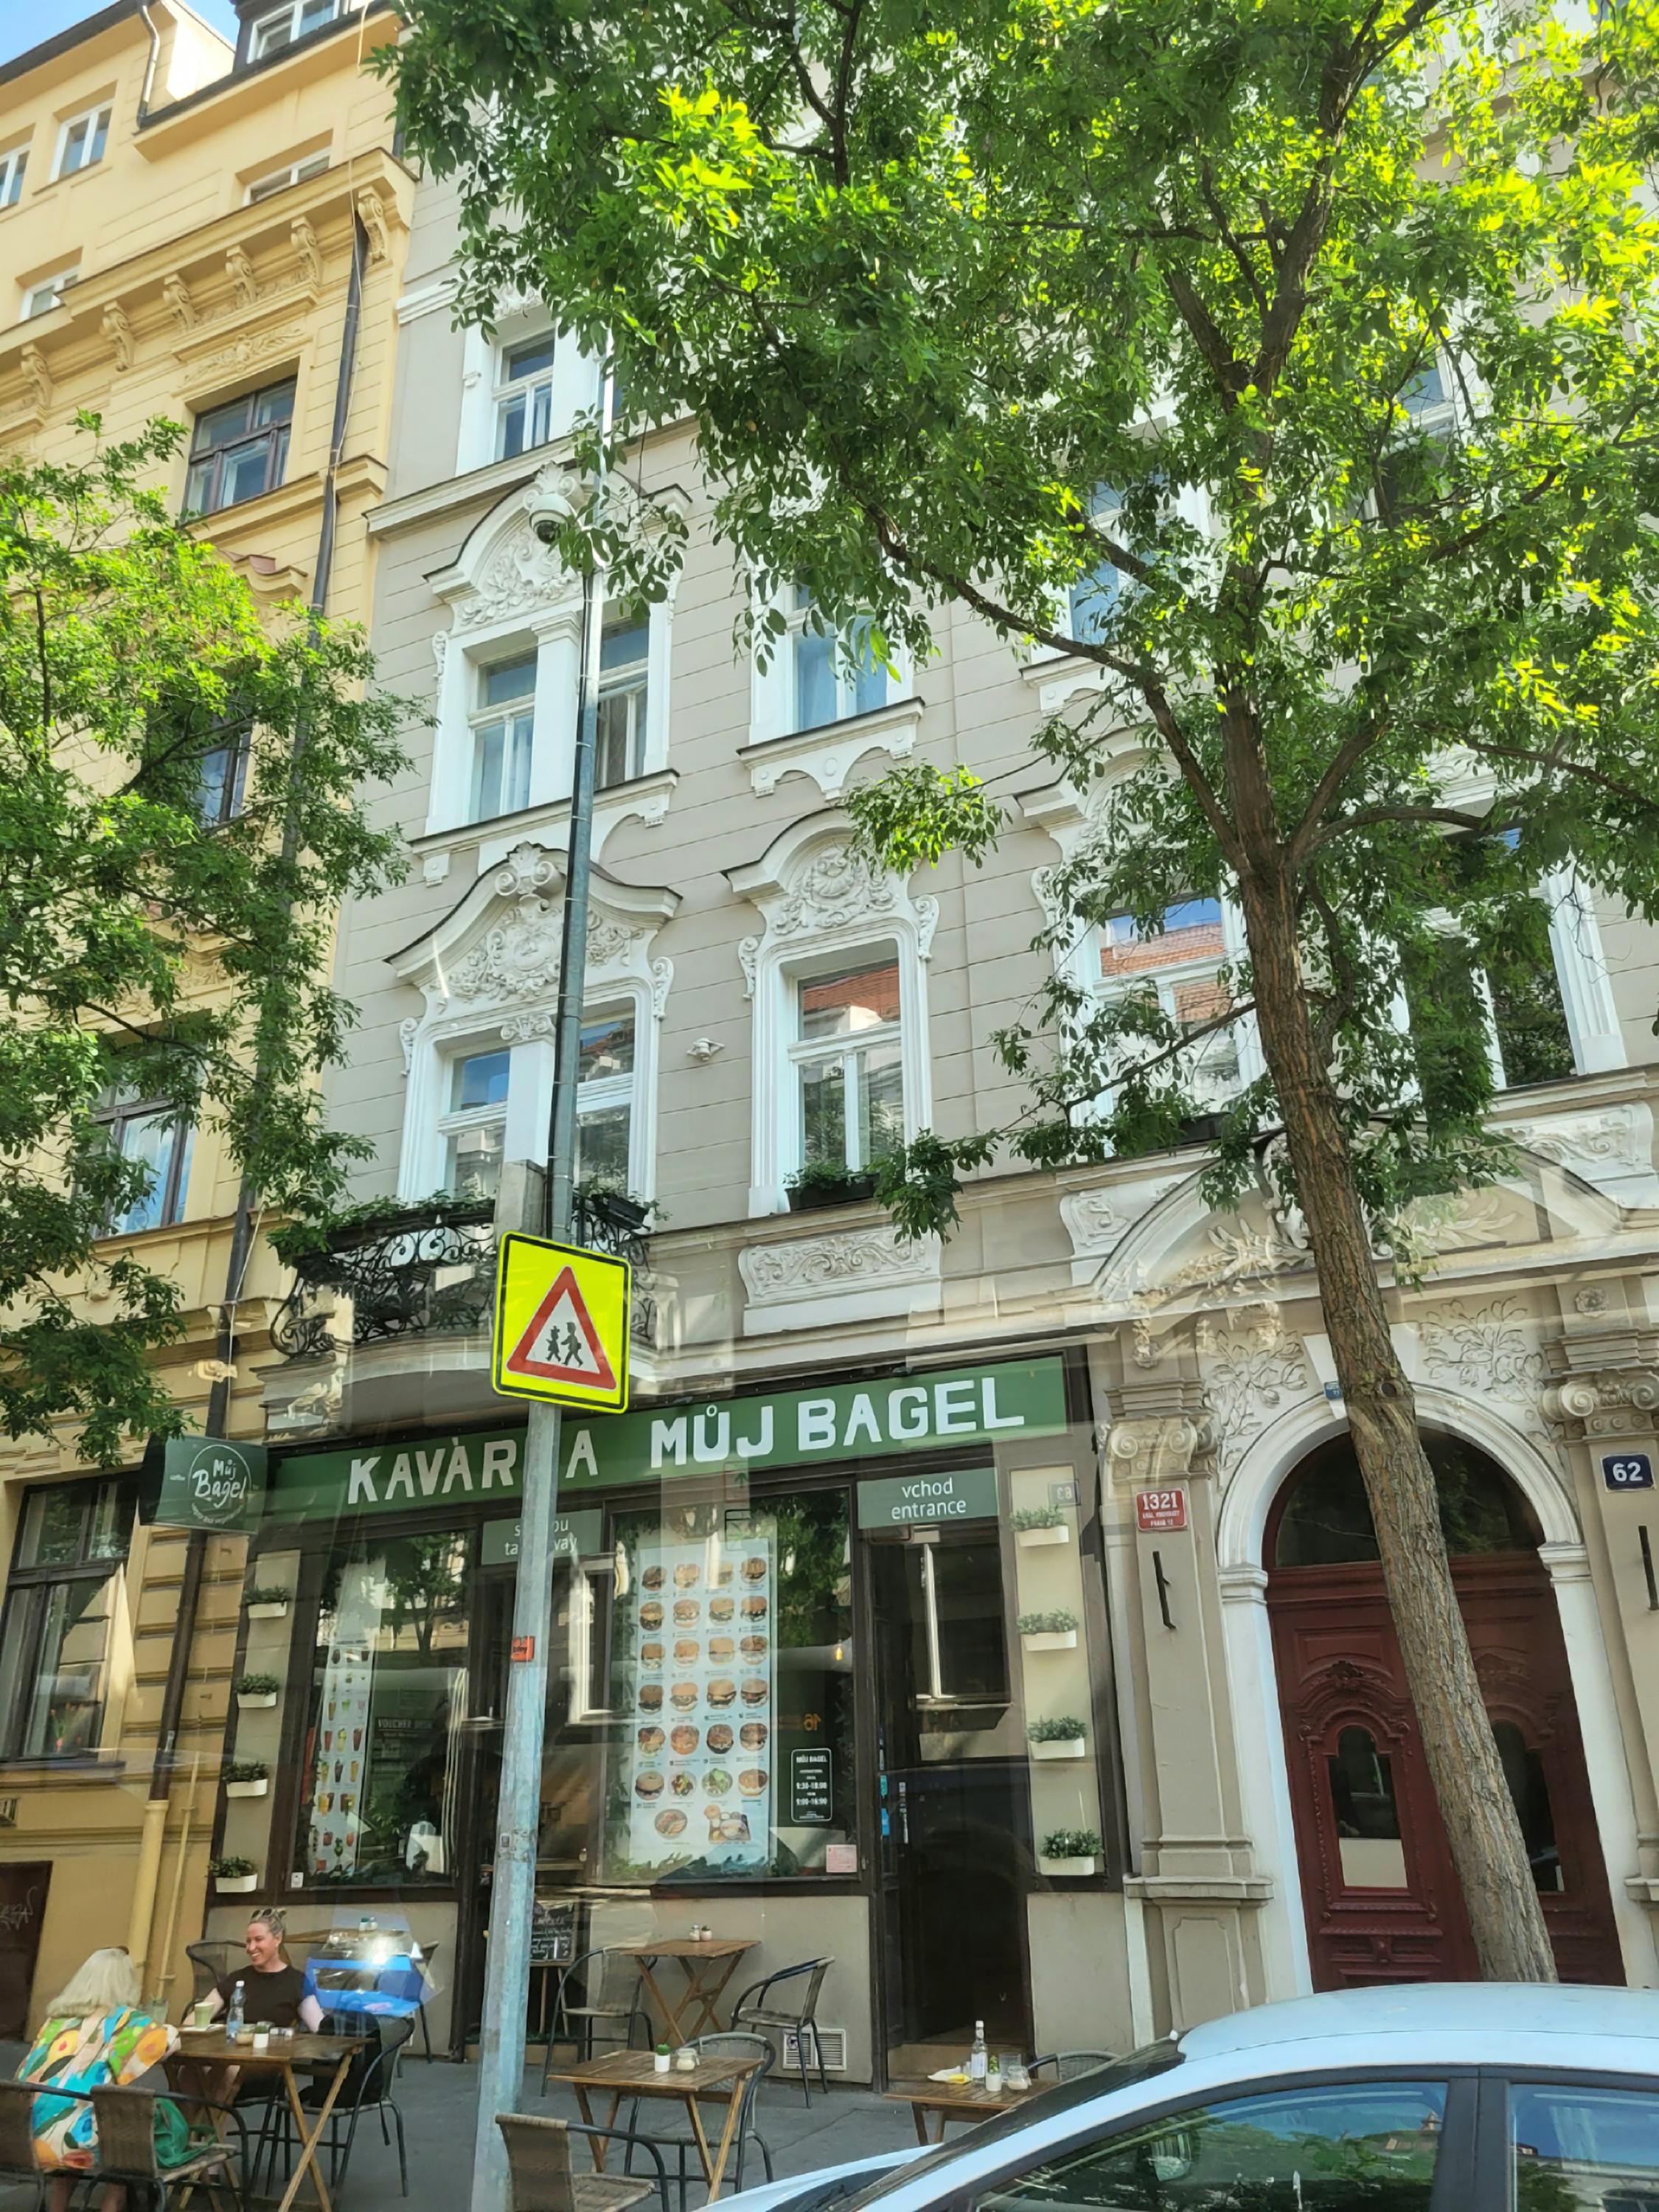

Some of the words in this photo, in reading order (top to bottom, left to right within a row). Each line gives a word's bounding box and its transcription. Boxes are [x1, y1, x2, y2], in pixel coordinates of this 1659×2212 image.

[650, 1404, 773, 1468] MŮJ
[798, 1377, 1025, 1451] BAGEL
[213, 1459, 236, 1480] Můj
[1613, 1461, 1644, 1482] 62
[192, 1469, 247, 1509] Bagel
[902, 1476, 953, 1498] vchod
[891, 1499, 967, 1520] entrance
[1143, 1492, 1178, 1511] 1321
